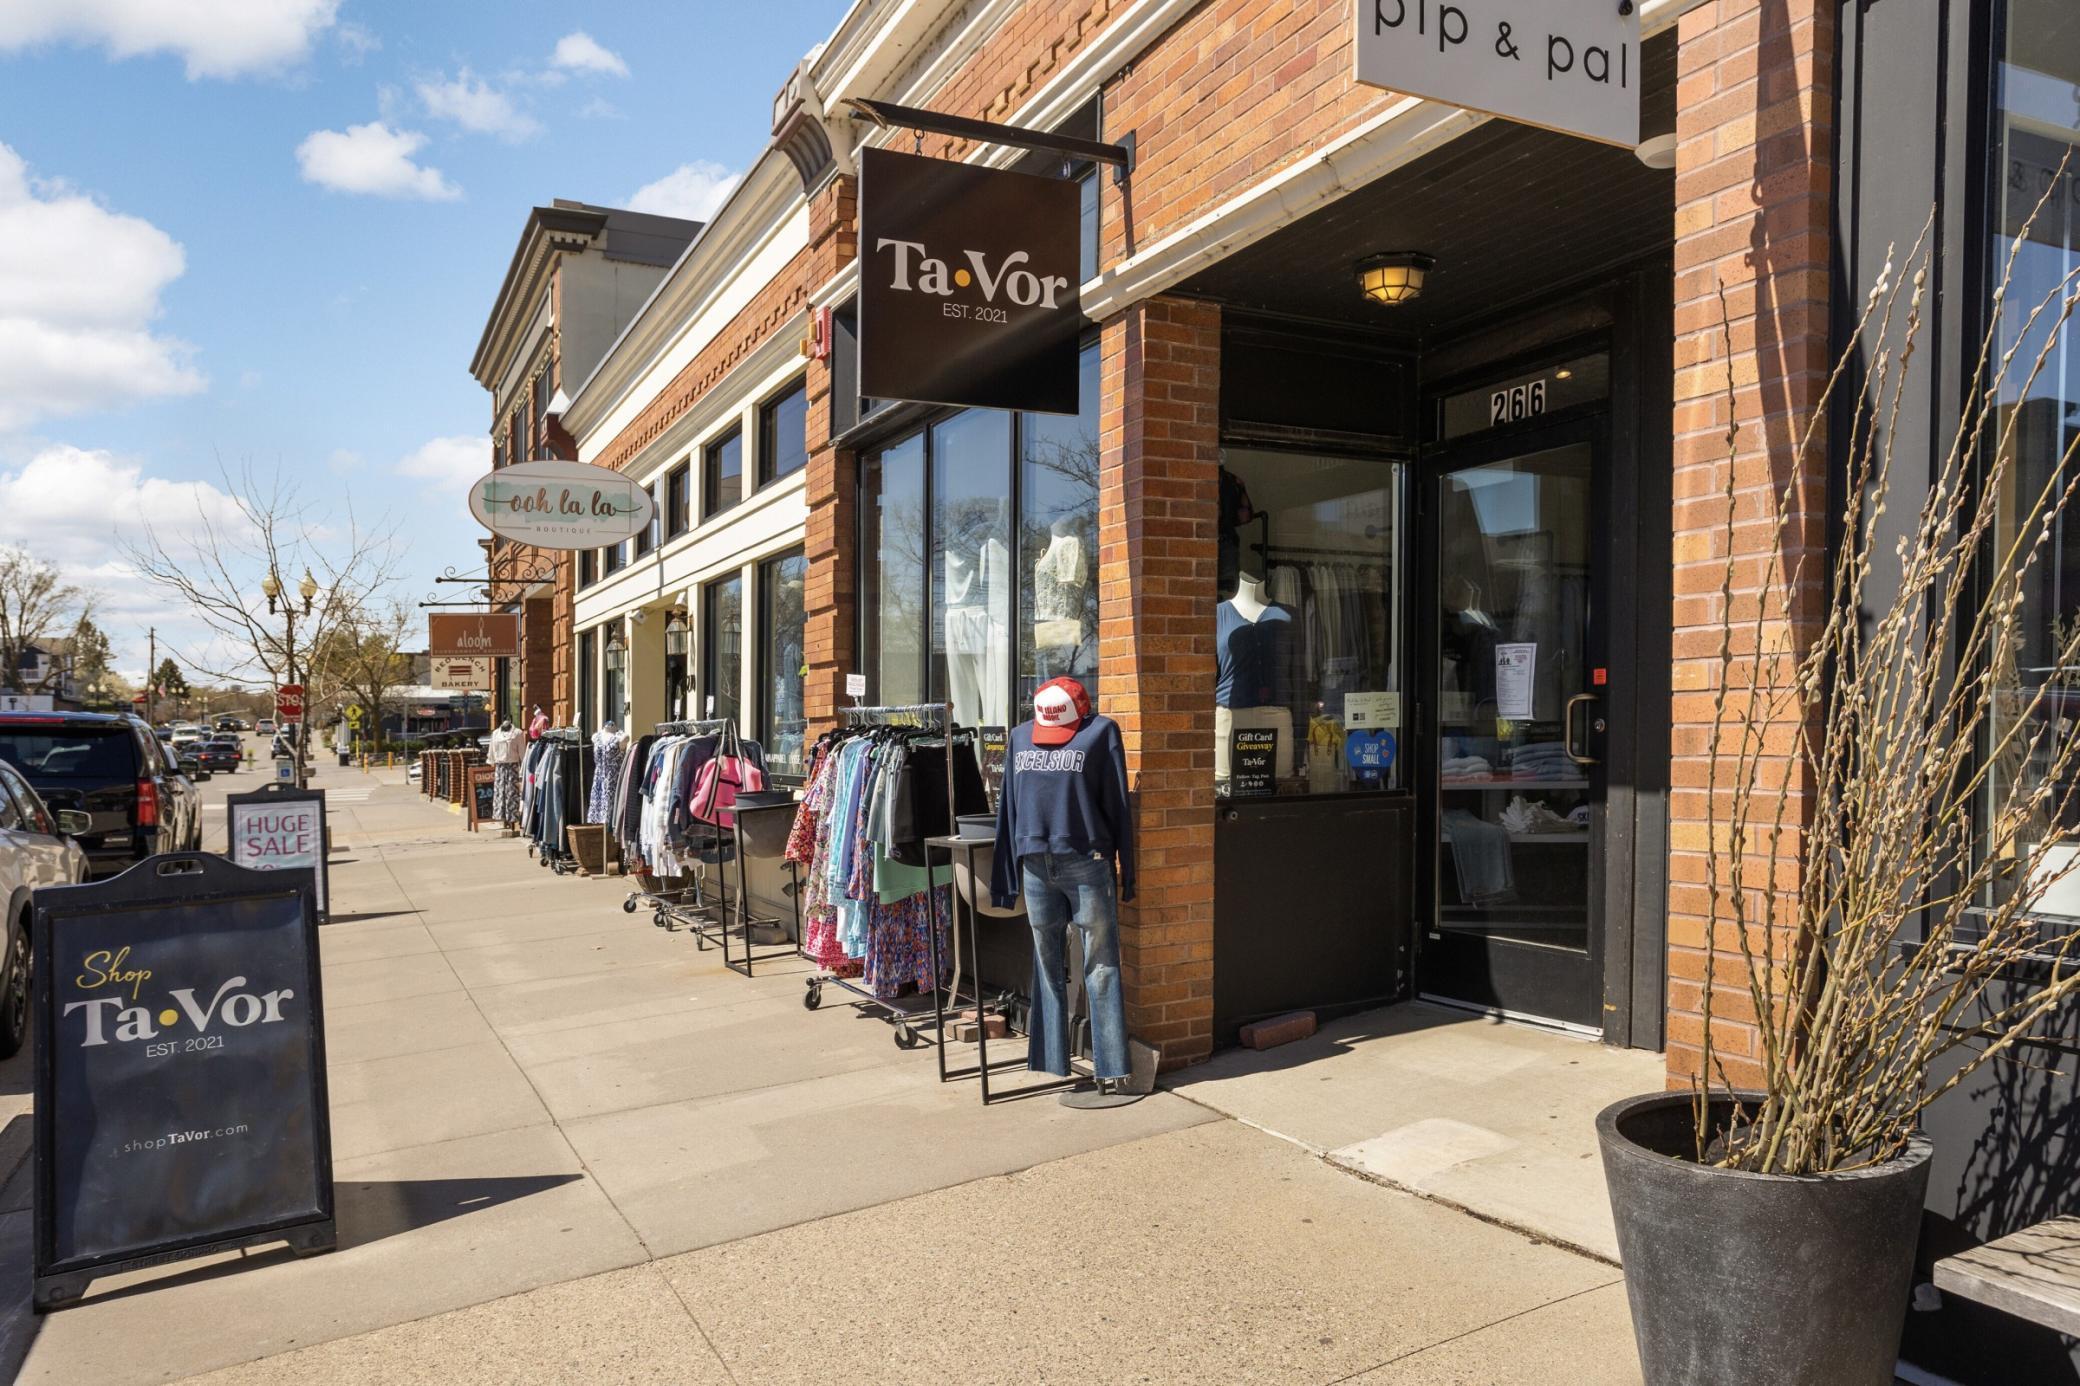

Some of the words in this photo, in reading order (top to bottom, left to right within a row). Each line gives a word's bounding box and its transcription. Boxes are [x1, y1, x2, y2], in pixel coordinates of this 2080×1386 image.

[1375, 0, 1468, 52] pip
[1495, 21, 1521, 61] &
[1548, 34, 1627, 88] pal
[943, 303, 972, 320] EST.
[975, 306, 1008, 323] 2021
[1493, 382, 1544, 426] 266
[497, 487, 553, 513] ooh
[559, 489, 586, 516] la
[591, 490, 627, 517] la
[536, 526, 592, 535] BOUTIQUE
[457, 629, 493, 649] aloom
[277, 693, 303, 707] STO
[1236, 742, 1274, 752] Giveaway
[1238, 733, 1253, 742] Gift
[1254, 733, 1273, 742] Card
[1364, 743, 1379, 754] SHOP
[1015, 749, 1086, 775] EXCELSIOR
[1362, 754, 1380, 765] SMALL
[247, 814, 310, 834] HUGE
[247, 834, 311, 857] SALE
[76, 946, 152, 999] Shop
[145, 1041, 182, 1058] EST.
[185, 1035, 225, 1053] 2021
[123, 1122, 249, 1153] shopTaVor.com
